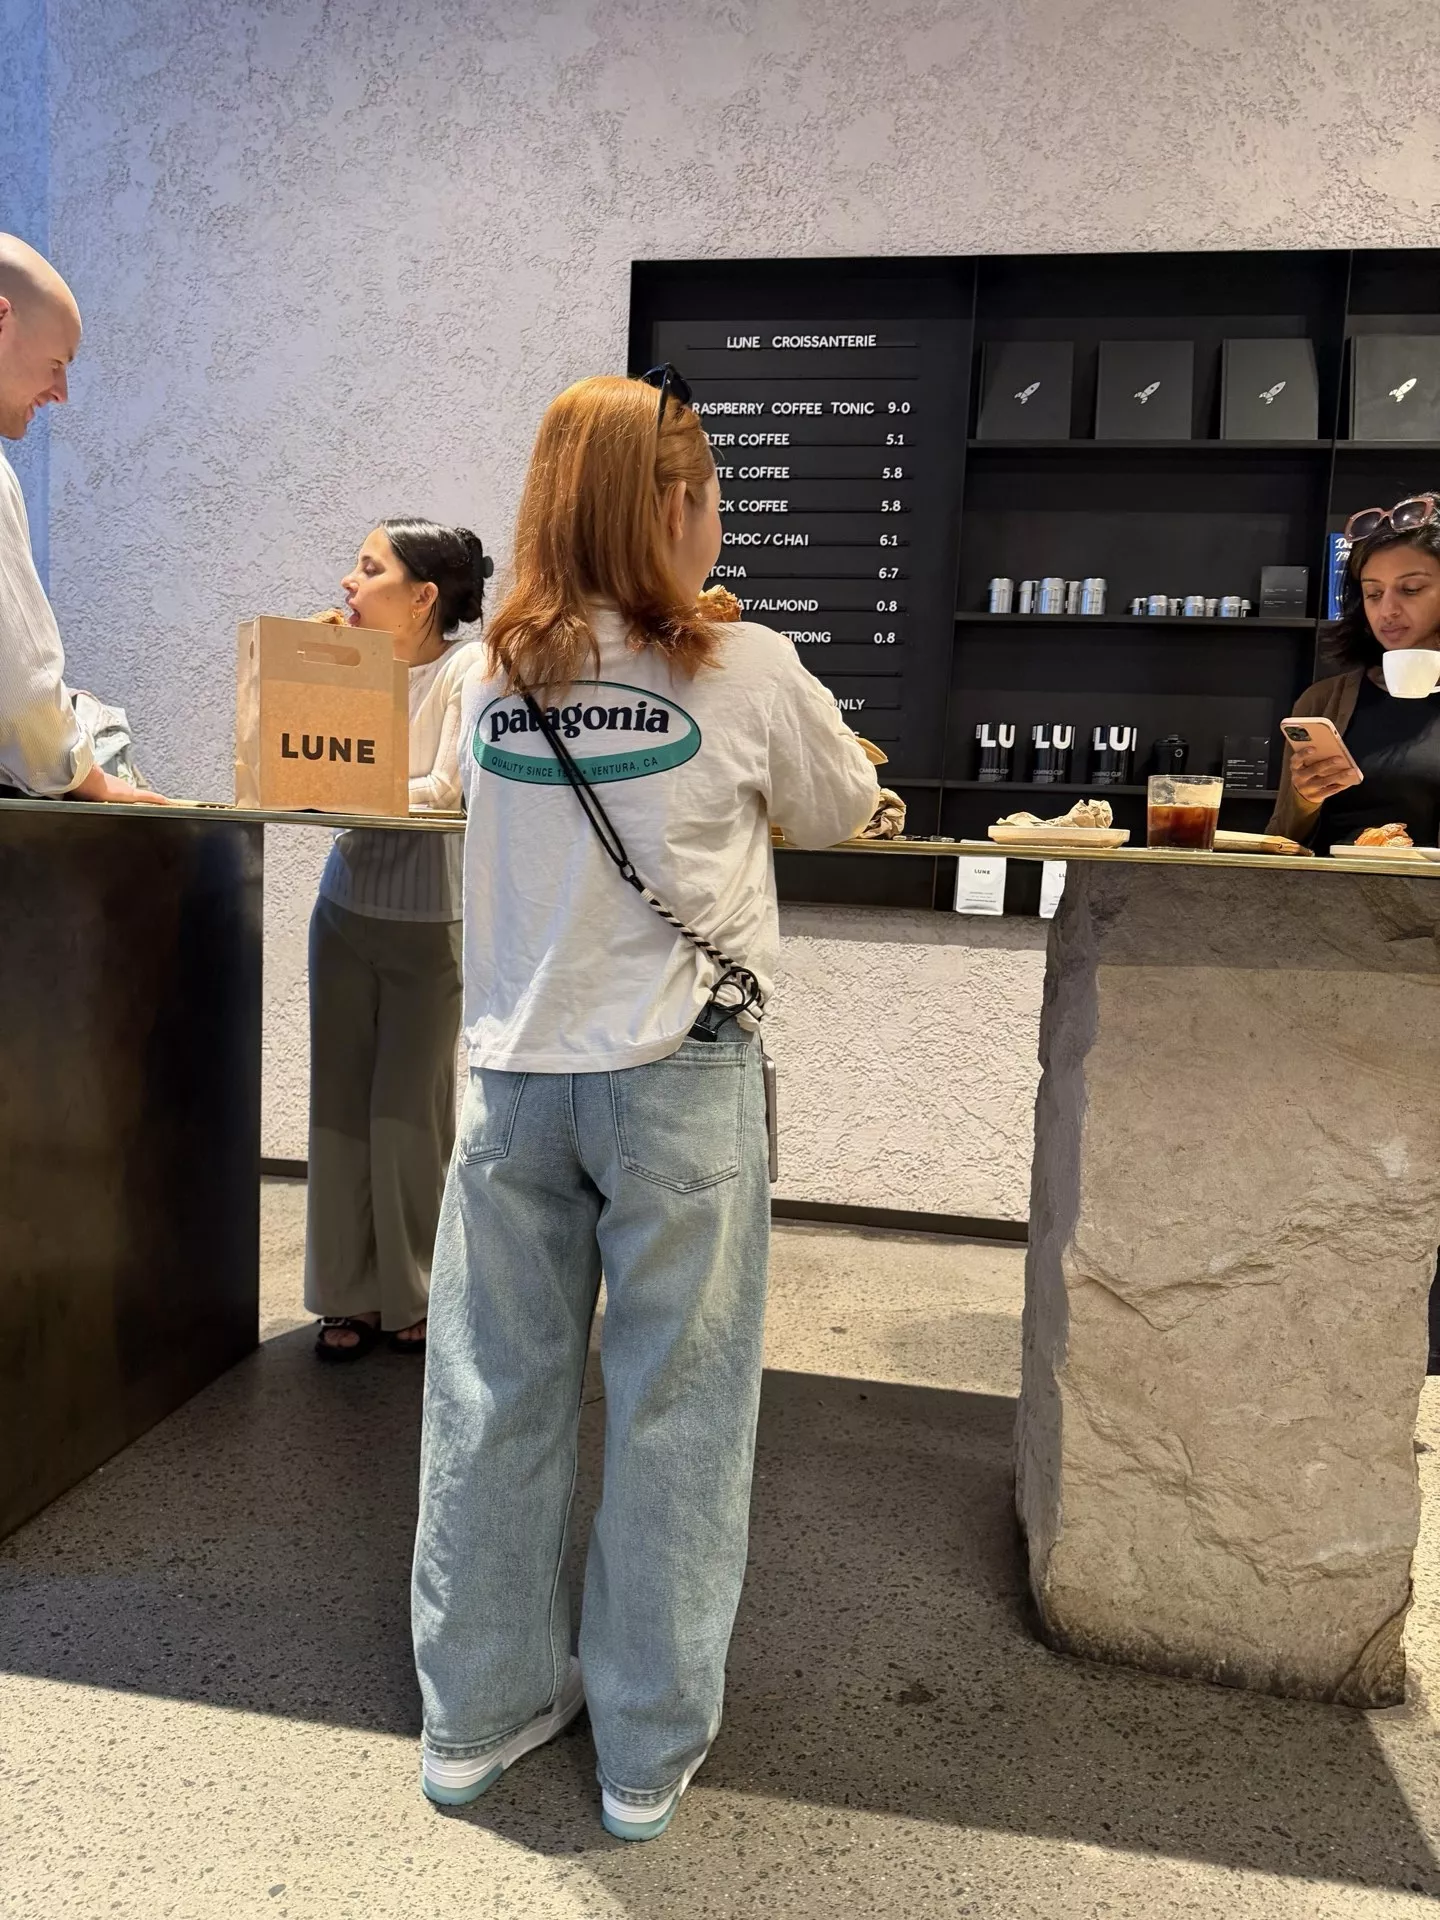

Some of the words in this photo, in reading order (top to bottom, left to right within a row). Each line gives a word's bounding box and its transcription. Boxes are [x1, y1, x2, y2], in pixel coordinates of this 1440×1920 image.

[727, 336, 760, 348] LUNE
[772, 335, 876, 348] CROISSANTERIE
[692, 402, 765, 415] RASPBERRY
[772, 402, 822, 414] COFFEE
[831, 402, 874, 414] TONIC
[888, 402, 910, 413] 9.0
[739, 434, 789, 445] COFFEE
[886, 434, 903, 445] 5.1
[739, 467, 789, 478] COFFEE
[883, 467, 902, 478] 5.8
[739, 500, 788, 512] COFFEE
[882, 501, 901, 511] 5.8
[880, 535, 897, 545] 6.1
[708, 566, 746, 578] TCHA
[879, 568, 898, 578] 6.7
[738, 600, 818, 612] AT/ALMOND
[877, 601, 897, 611] 0.8
[874, 632, 895, 643] 0.8
[490, 700, 670, 742] patagonia
[1035, 725, 1076, 750] LU
[282, 733, 375, 764] LUNE
[492, 757, 524, 774] QUALITY
[527, 766, 552, 777] SINCE
[592, 762, 639, 776] VENTURA,
[644, 757, 658, 767] CA
